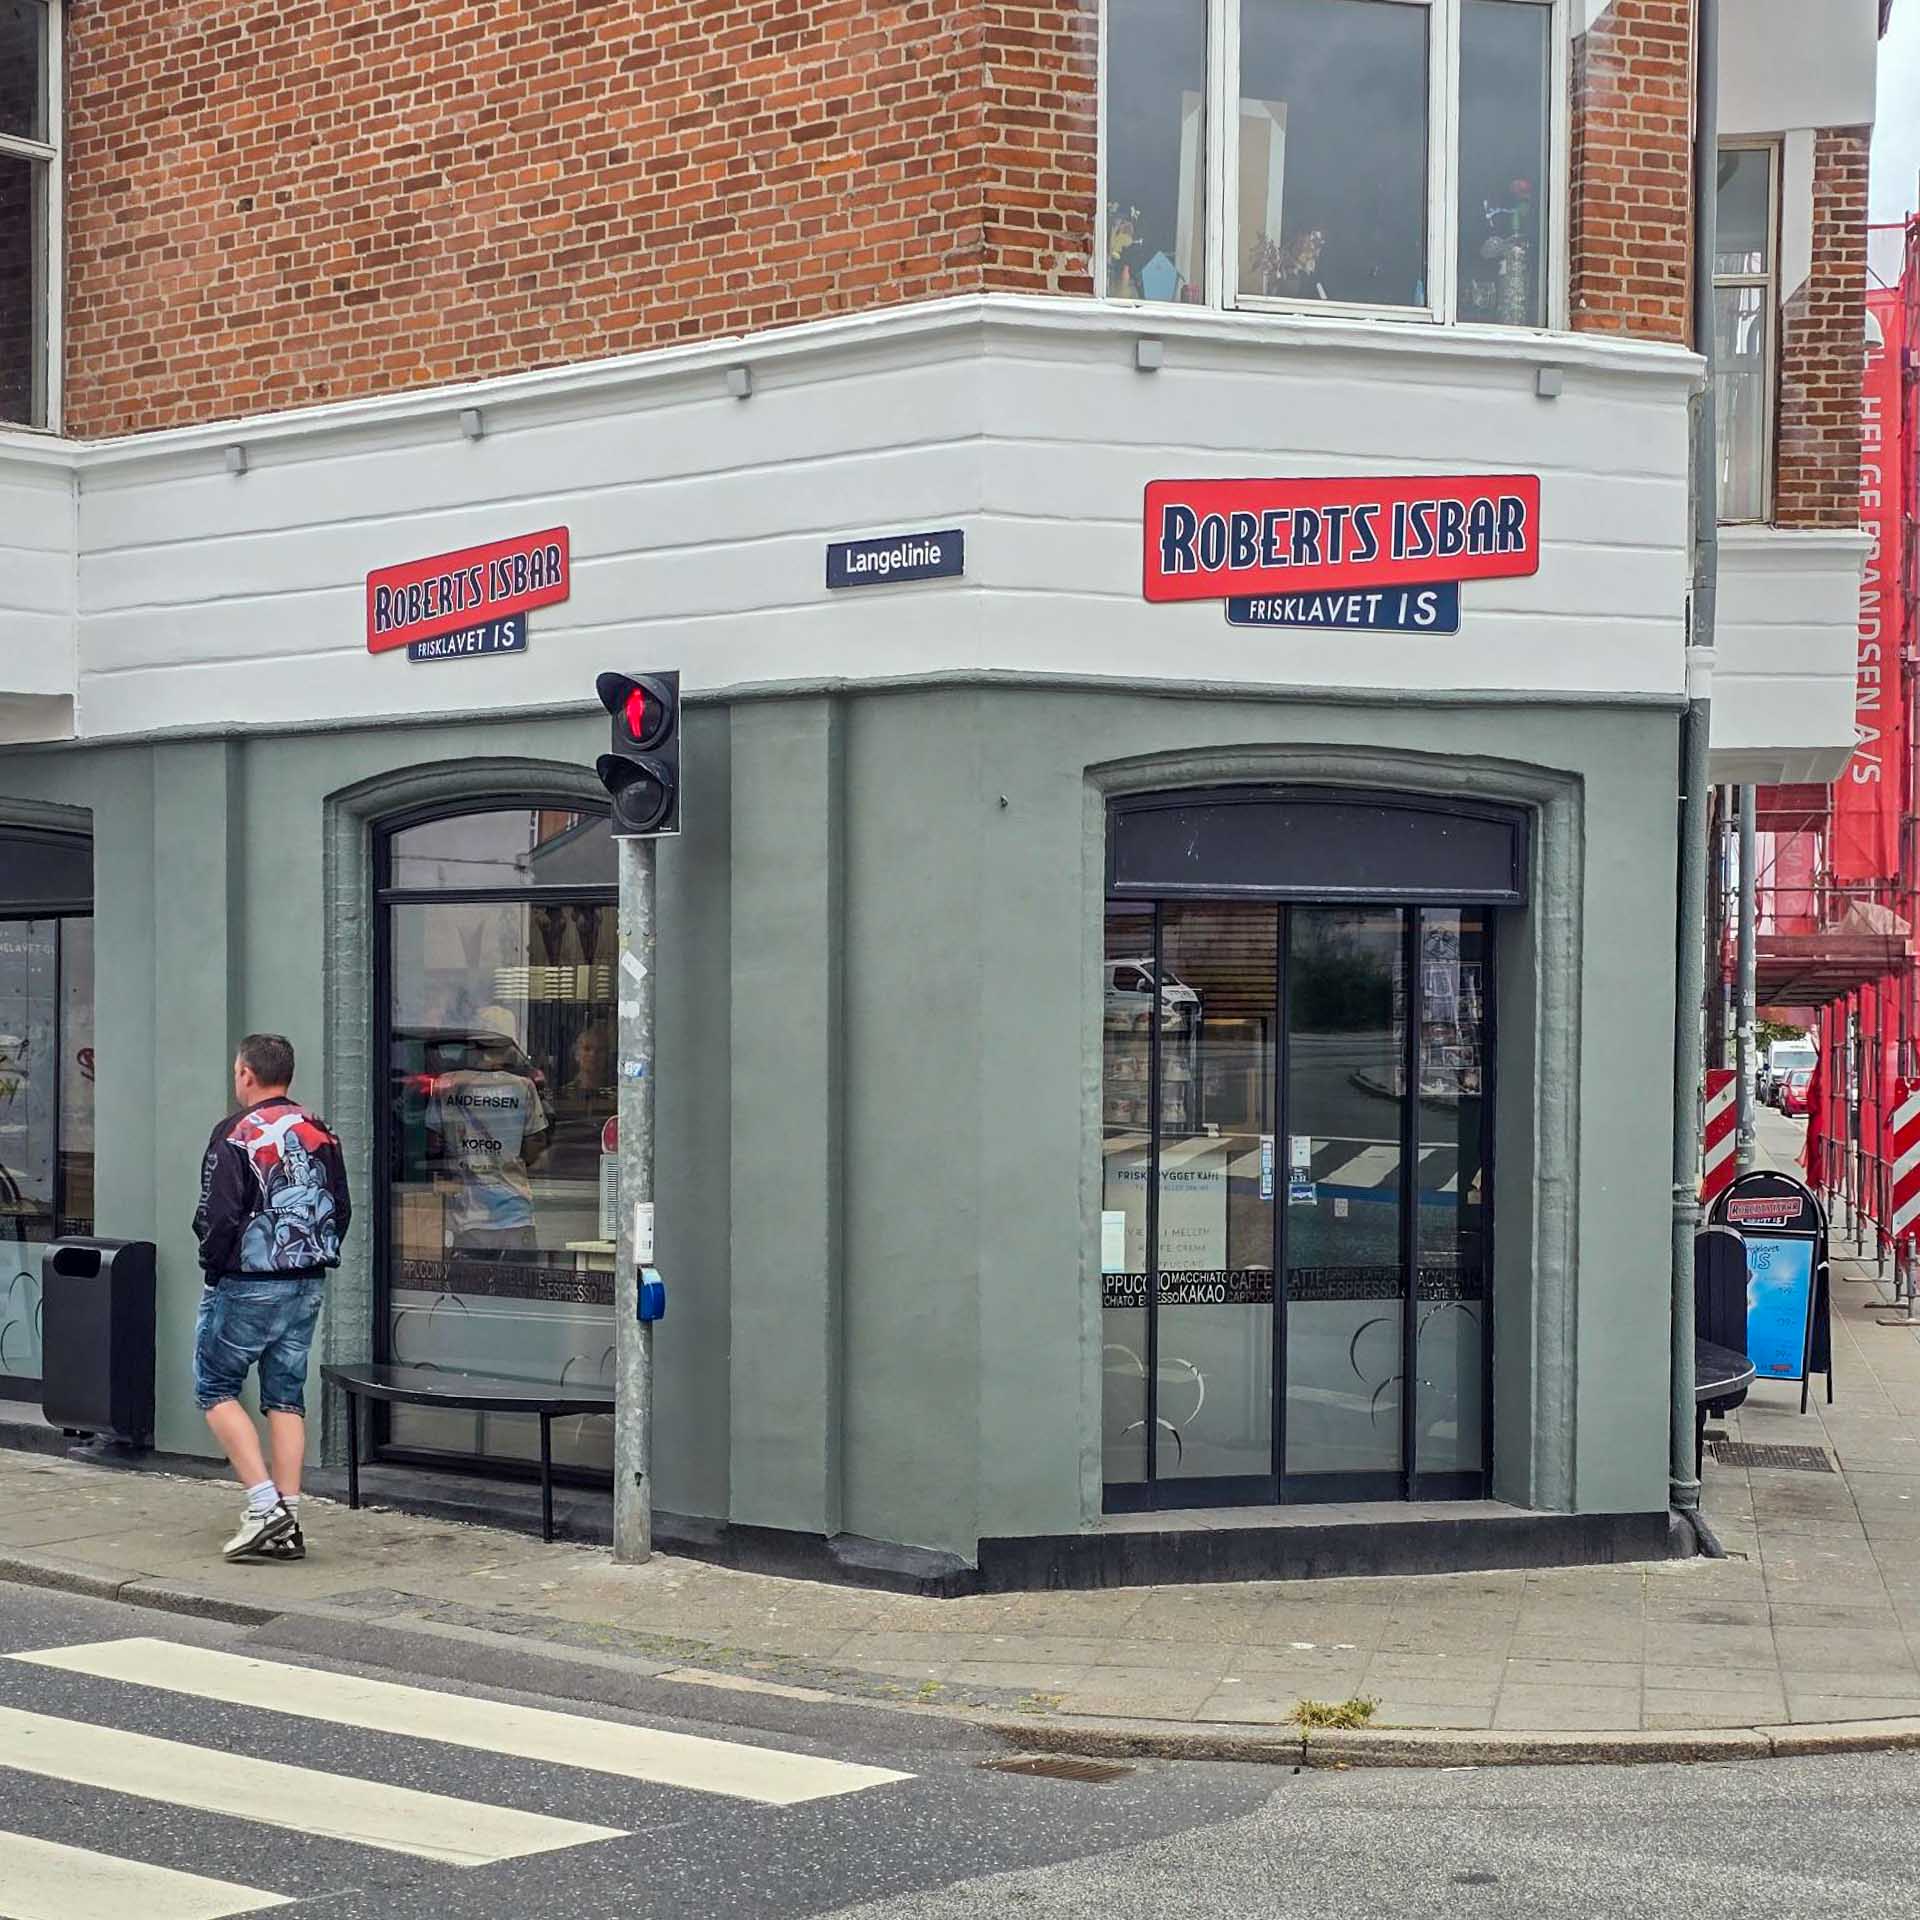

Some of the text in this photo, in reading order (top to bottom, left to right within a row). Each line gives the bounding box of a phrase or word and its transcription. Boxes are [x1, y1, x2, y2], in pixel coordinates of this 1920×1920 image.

[1160, 495, 1527, 575] ROBERTS ISBAR
[846, 540, 942, 575] Langelinie
[374, 543, 562, 634] ROBERTS ISBAR
[1249, 590, 1437, 625] FRISKLAVET IS
[417, 621, 515, 657] FRISKLAVET IS
[1852, 723, 1882, 785] A/S
[446, 1095, 519, 1110] ANDERSEN
[462, 1139, 502, 1151] KOFOD
[1117, 1171, 1195, 1181] FRISKYGGET
[1179, 1284, 1225, 1303] KAKAO
